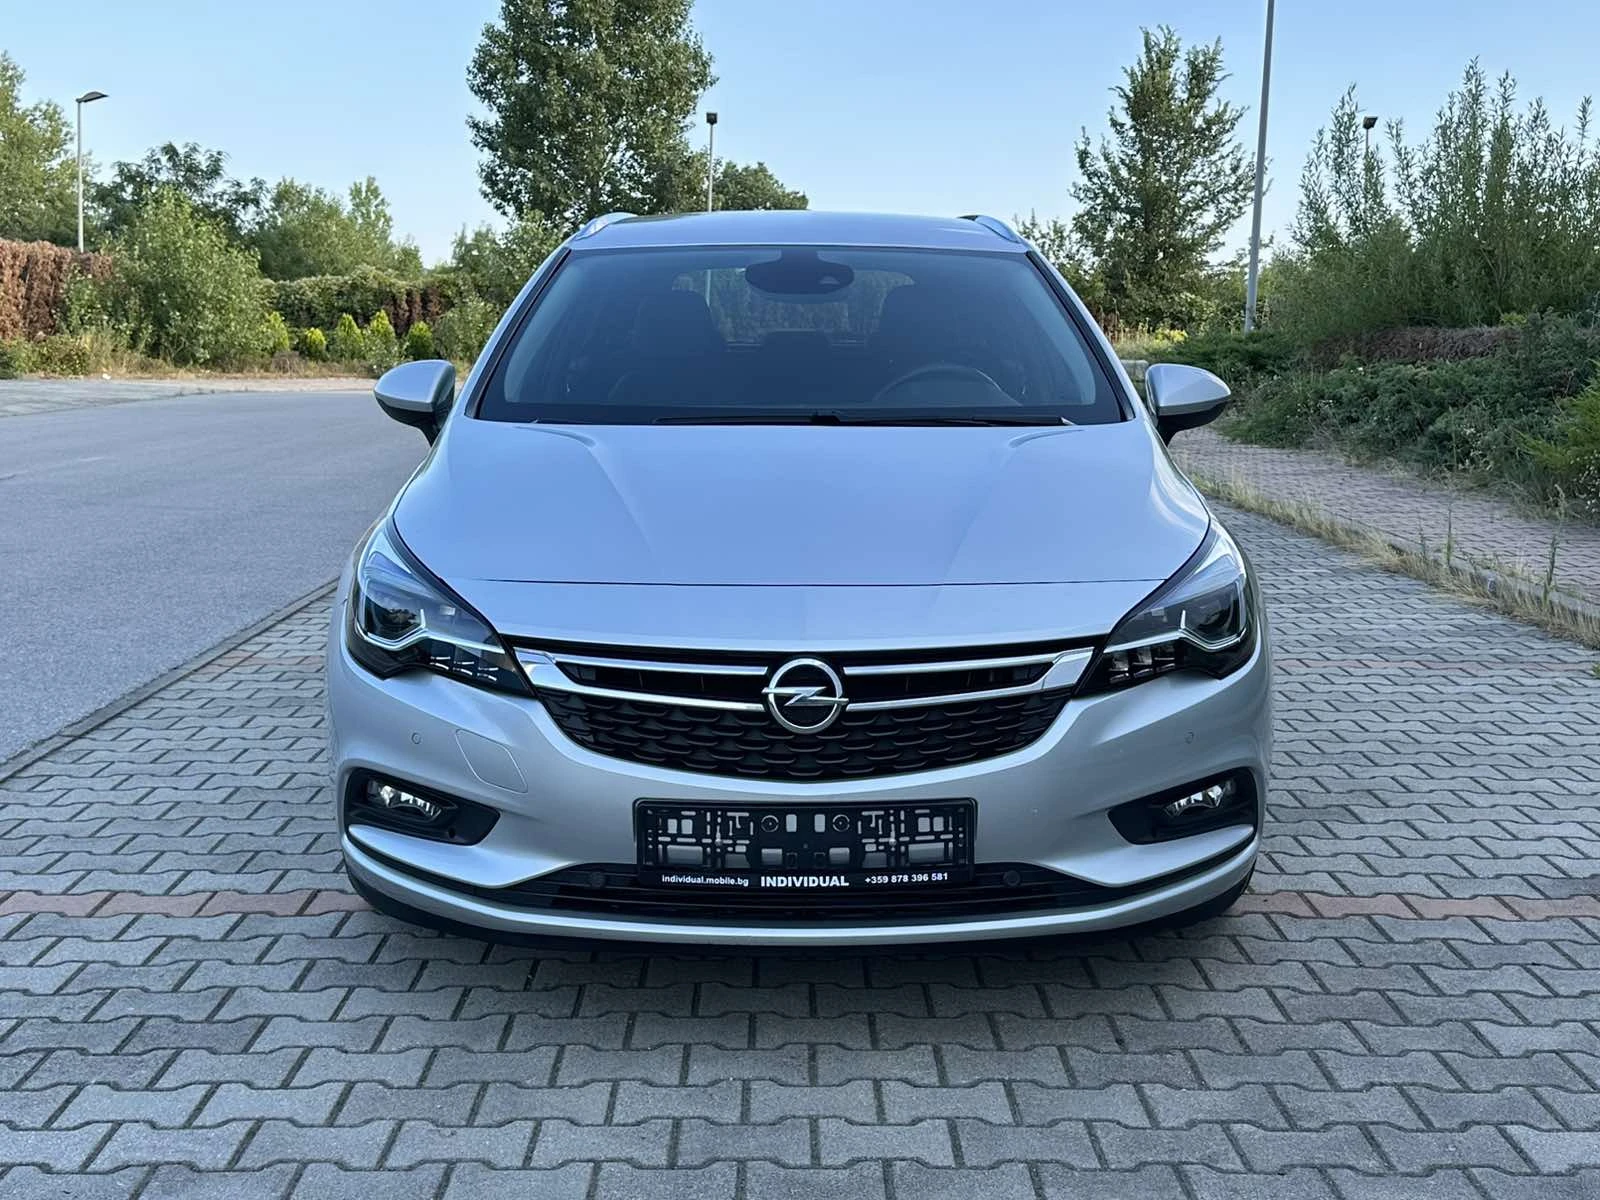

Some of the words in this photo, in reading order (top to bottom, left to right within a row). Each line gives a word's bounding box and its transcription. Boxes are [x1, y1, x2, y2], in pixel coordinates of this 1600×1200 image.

[760, 876, 850, 888] INDIVIDUAL
[864, 875, 889, 884] +359
[890, 874, 909, 883] 878
[911, 873, 929, 882] 396
[931, 872, 948, 881] 581
